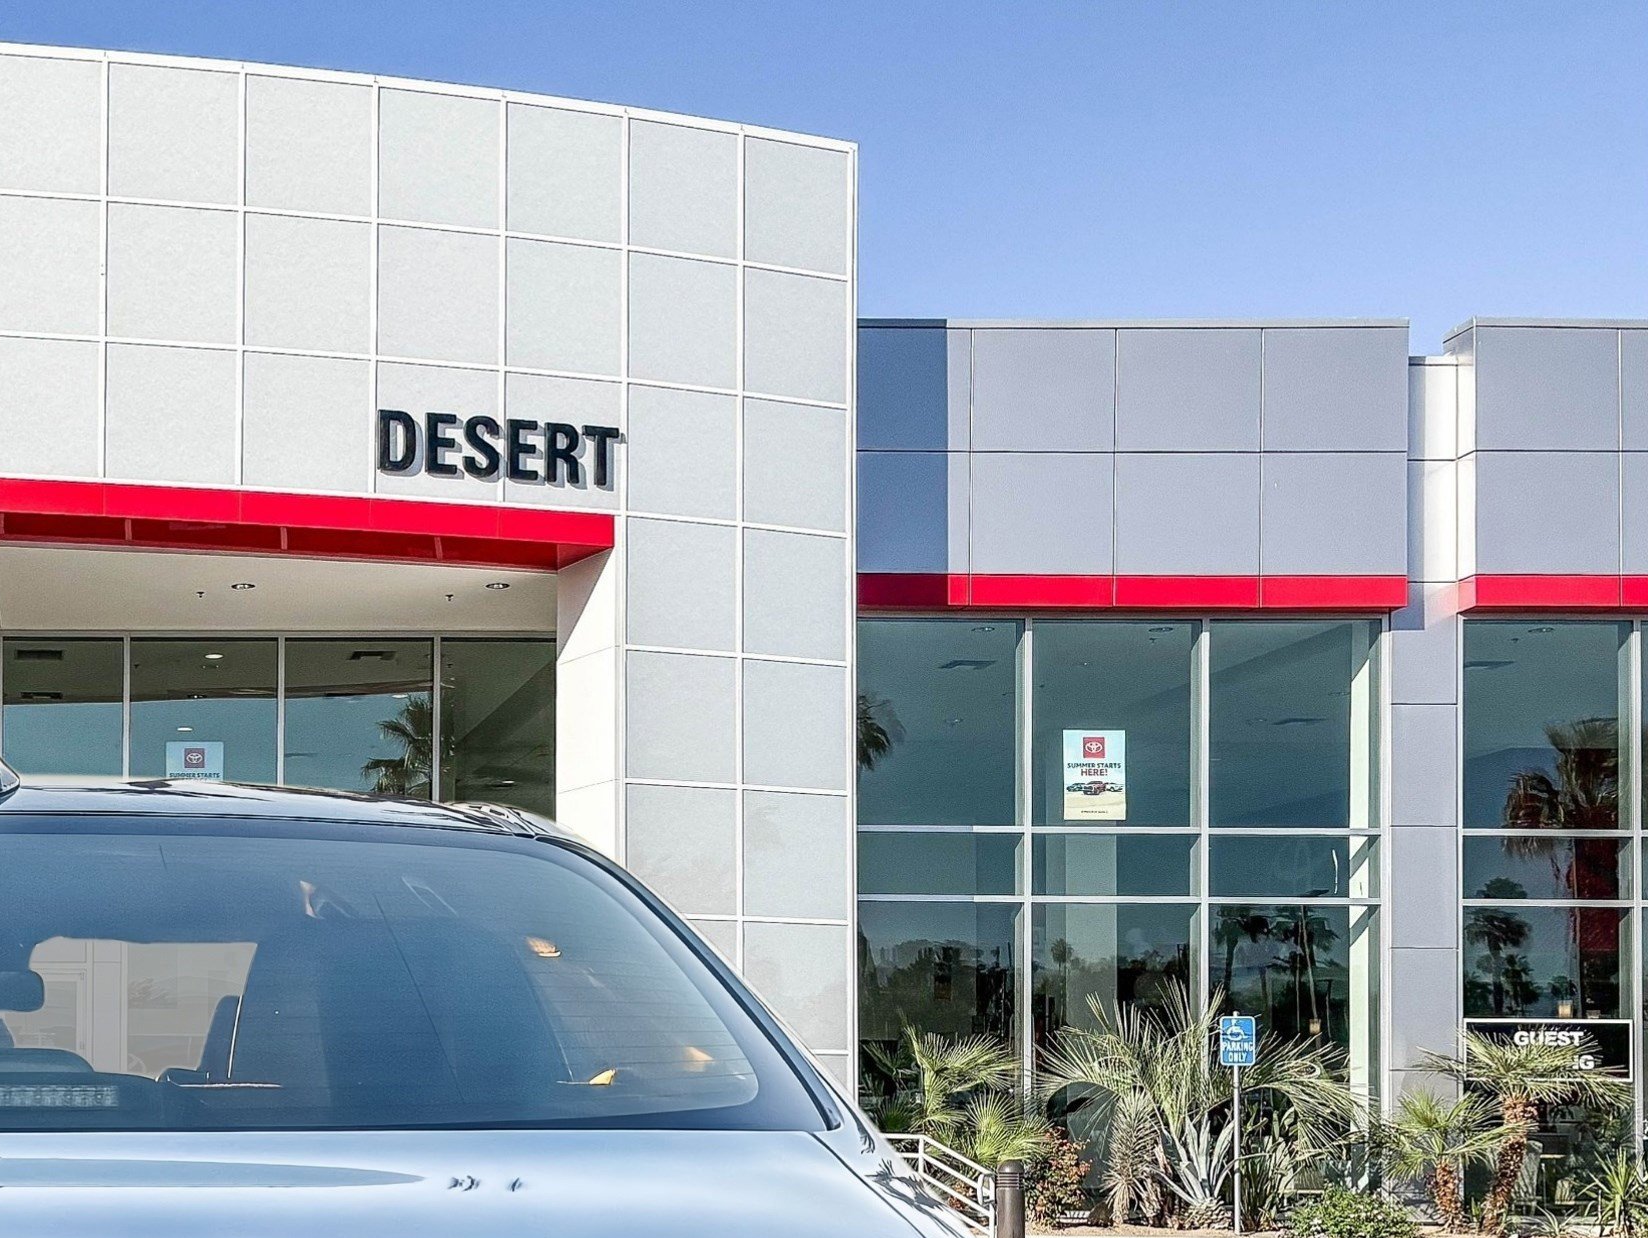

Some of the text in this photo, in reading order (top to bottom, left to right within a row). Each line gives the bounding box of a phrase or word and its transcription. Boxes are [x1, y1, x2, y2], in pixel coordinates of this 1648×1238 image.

[377, 409, 619, 487] DESERT
[1514, 1031, 1584, 1046] GUEST
[1222, 1041, 1253, 1052] PARKING
[1228, 1052, 1248, 1063] ONLY
